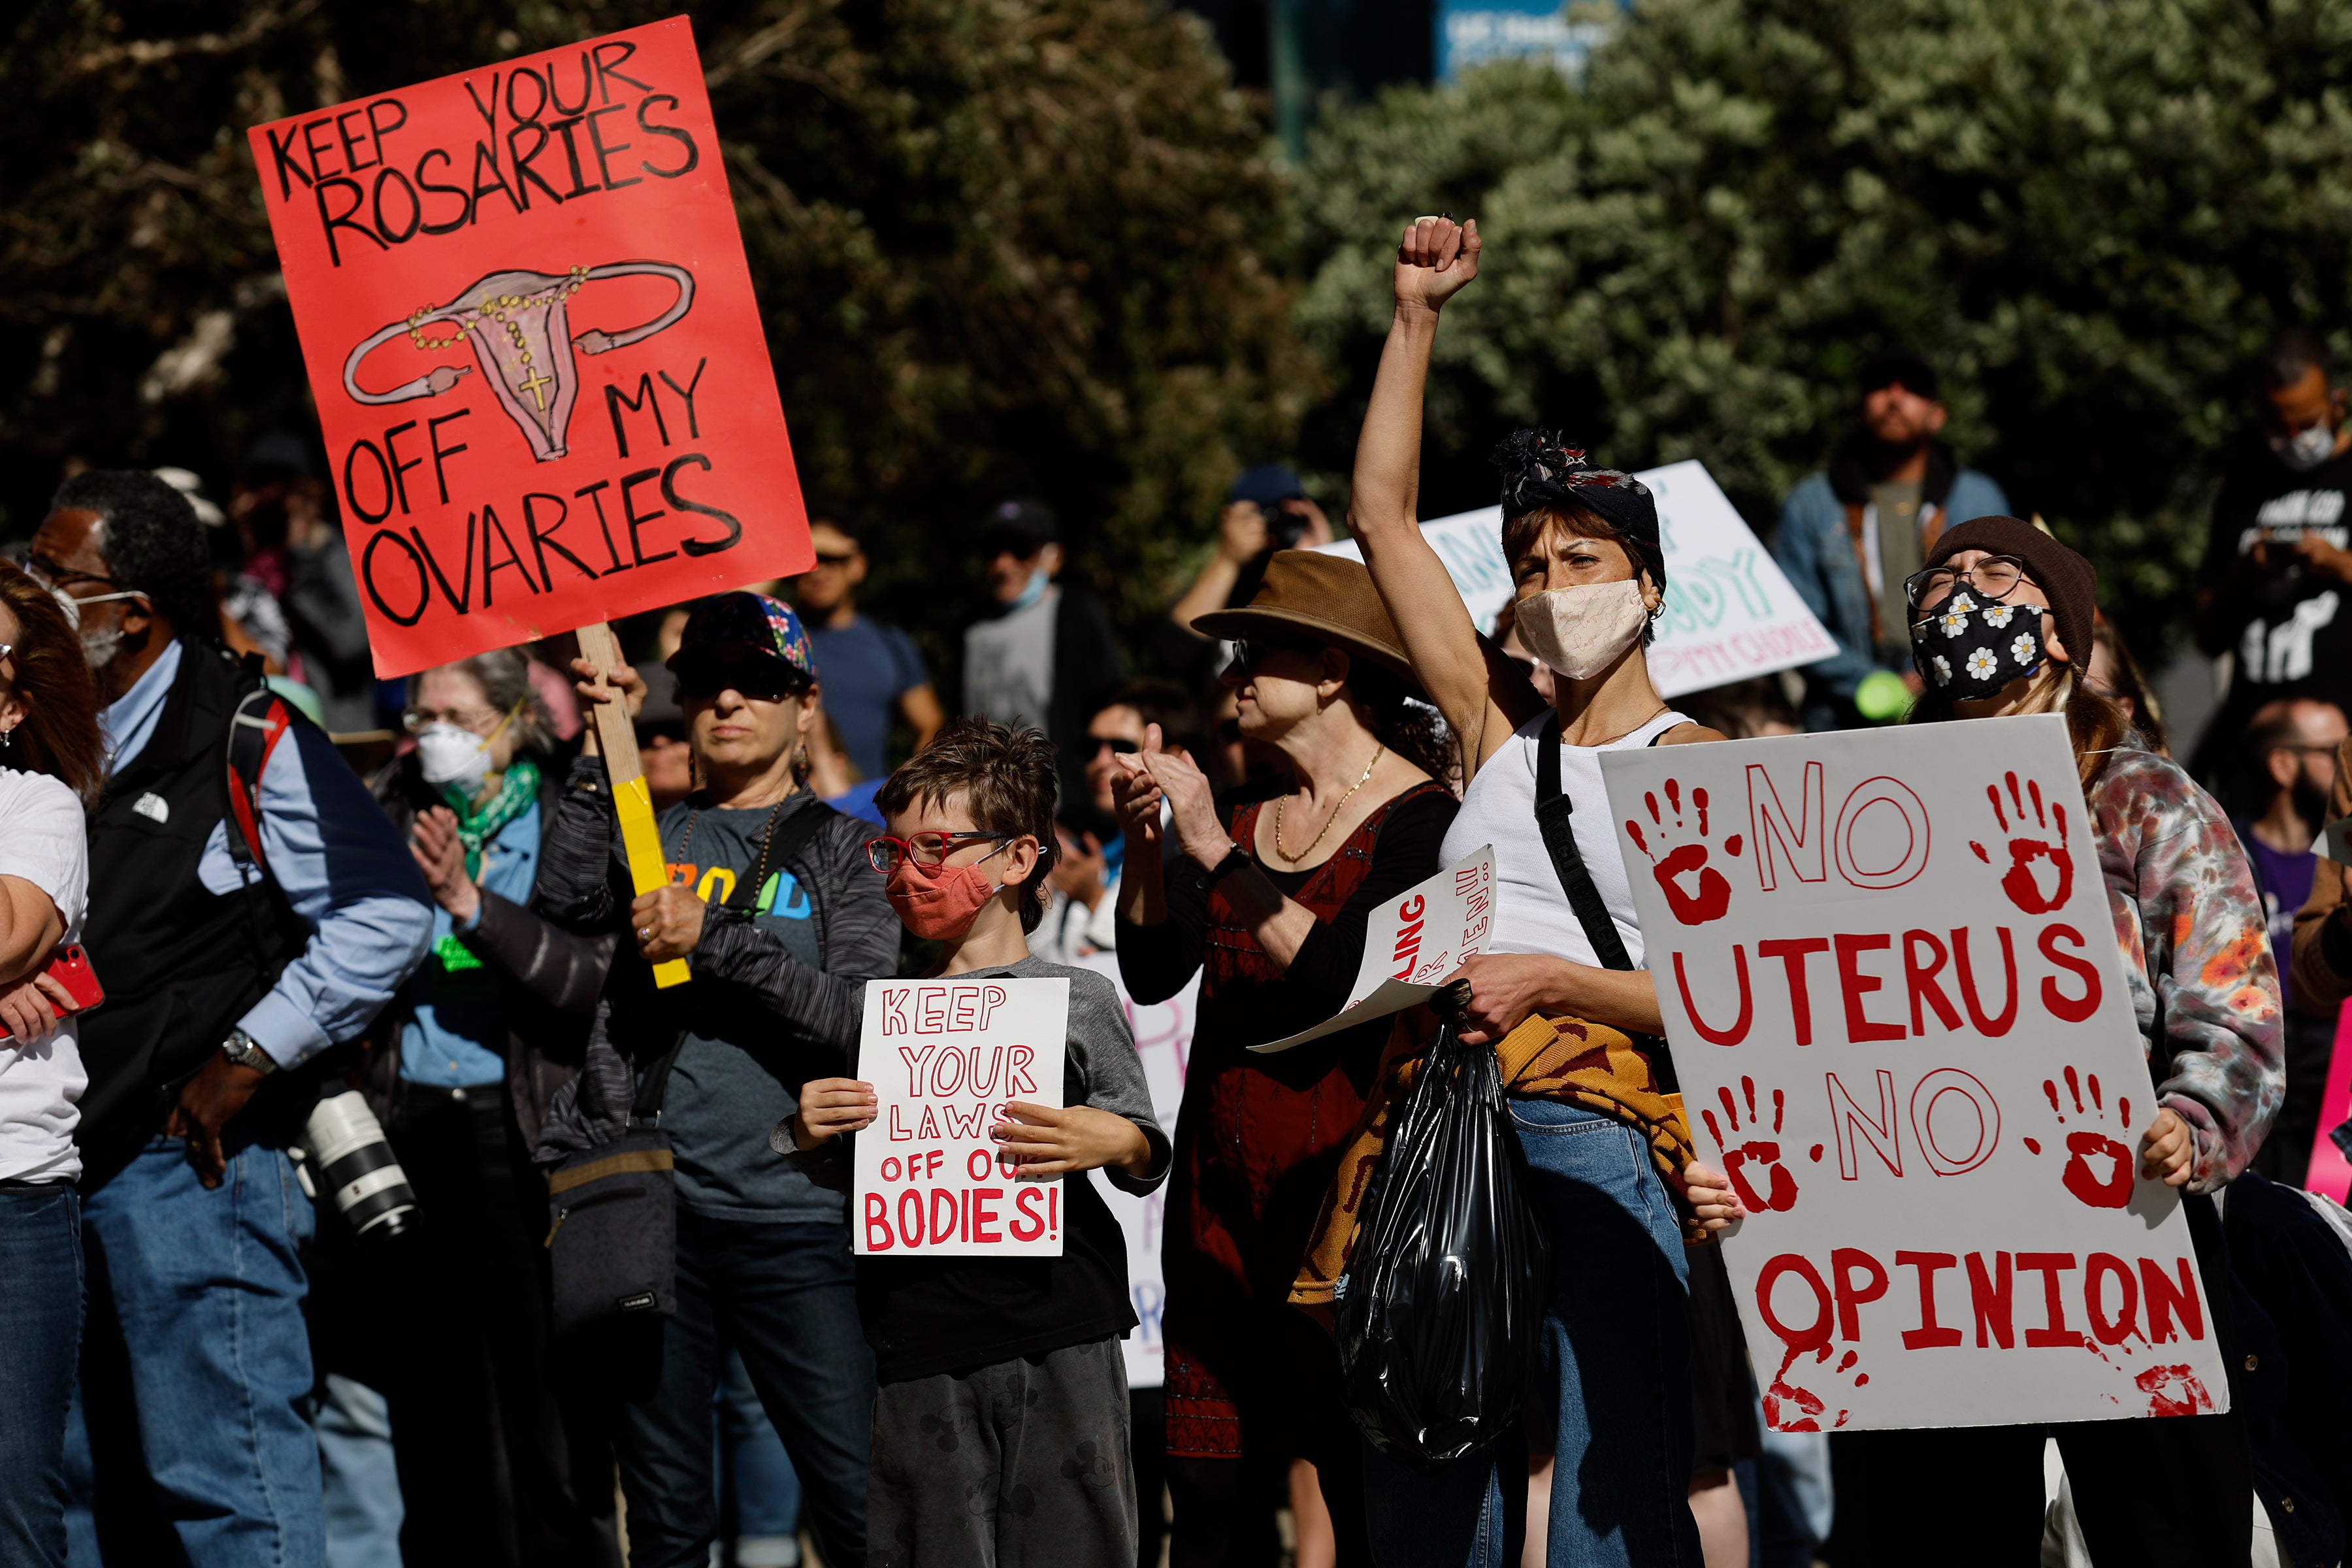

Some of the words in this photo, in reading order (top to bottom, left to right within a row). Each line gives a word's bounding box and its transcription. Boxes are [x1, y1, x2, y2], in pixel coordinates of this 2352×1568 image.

[267, 98, 406, 202] KEEP
[464, 41, 654, 169] YOUR
[314, 93, 699, 268] ROSARIES
[344, 408, 470, 525] OFF
[604, 357, 707, 459] MY
[362, 453, 743, 627] OVARIES
[1746, 760, 1931, 891] NO
[1391, 894, 1426, 983] LING
[1673, 923, 2102, 1047] UTERUS
[882, 986, 1007, 1036] KEEP
[889, 1103, 1017, 1145] LAWS
[898, 1045, 1038, 1098] YOUR
[1825, 1067, 2001, 1181] NO
[864, 1186, 1058, 1252] BODIES!
[881, 1149, 943, 1182] OFF
[1756, 1247, 2205, 1354] OPINION
